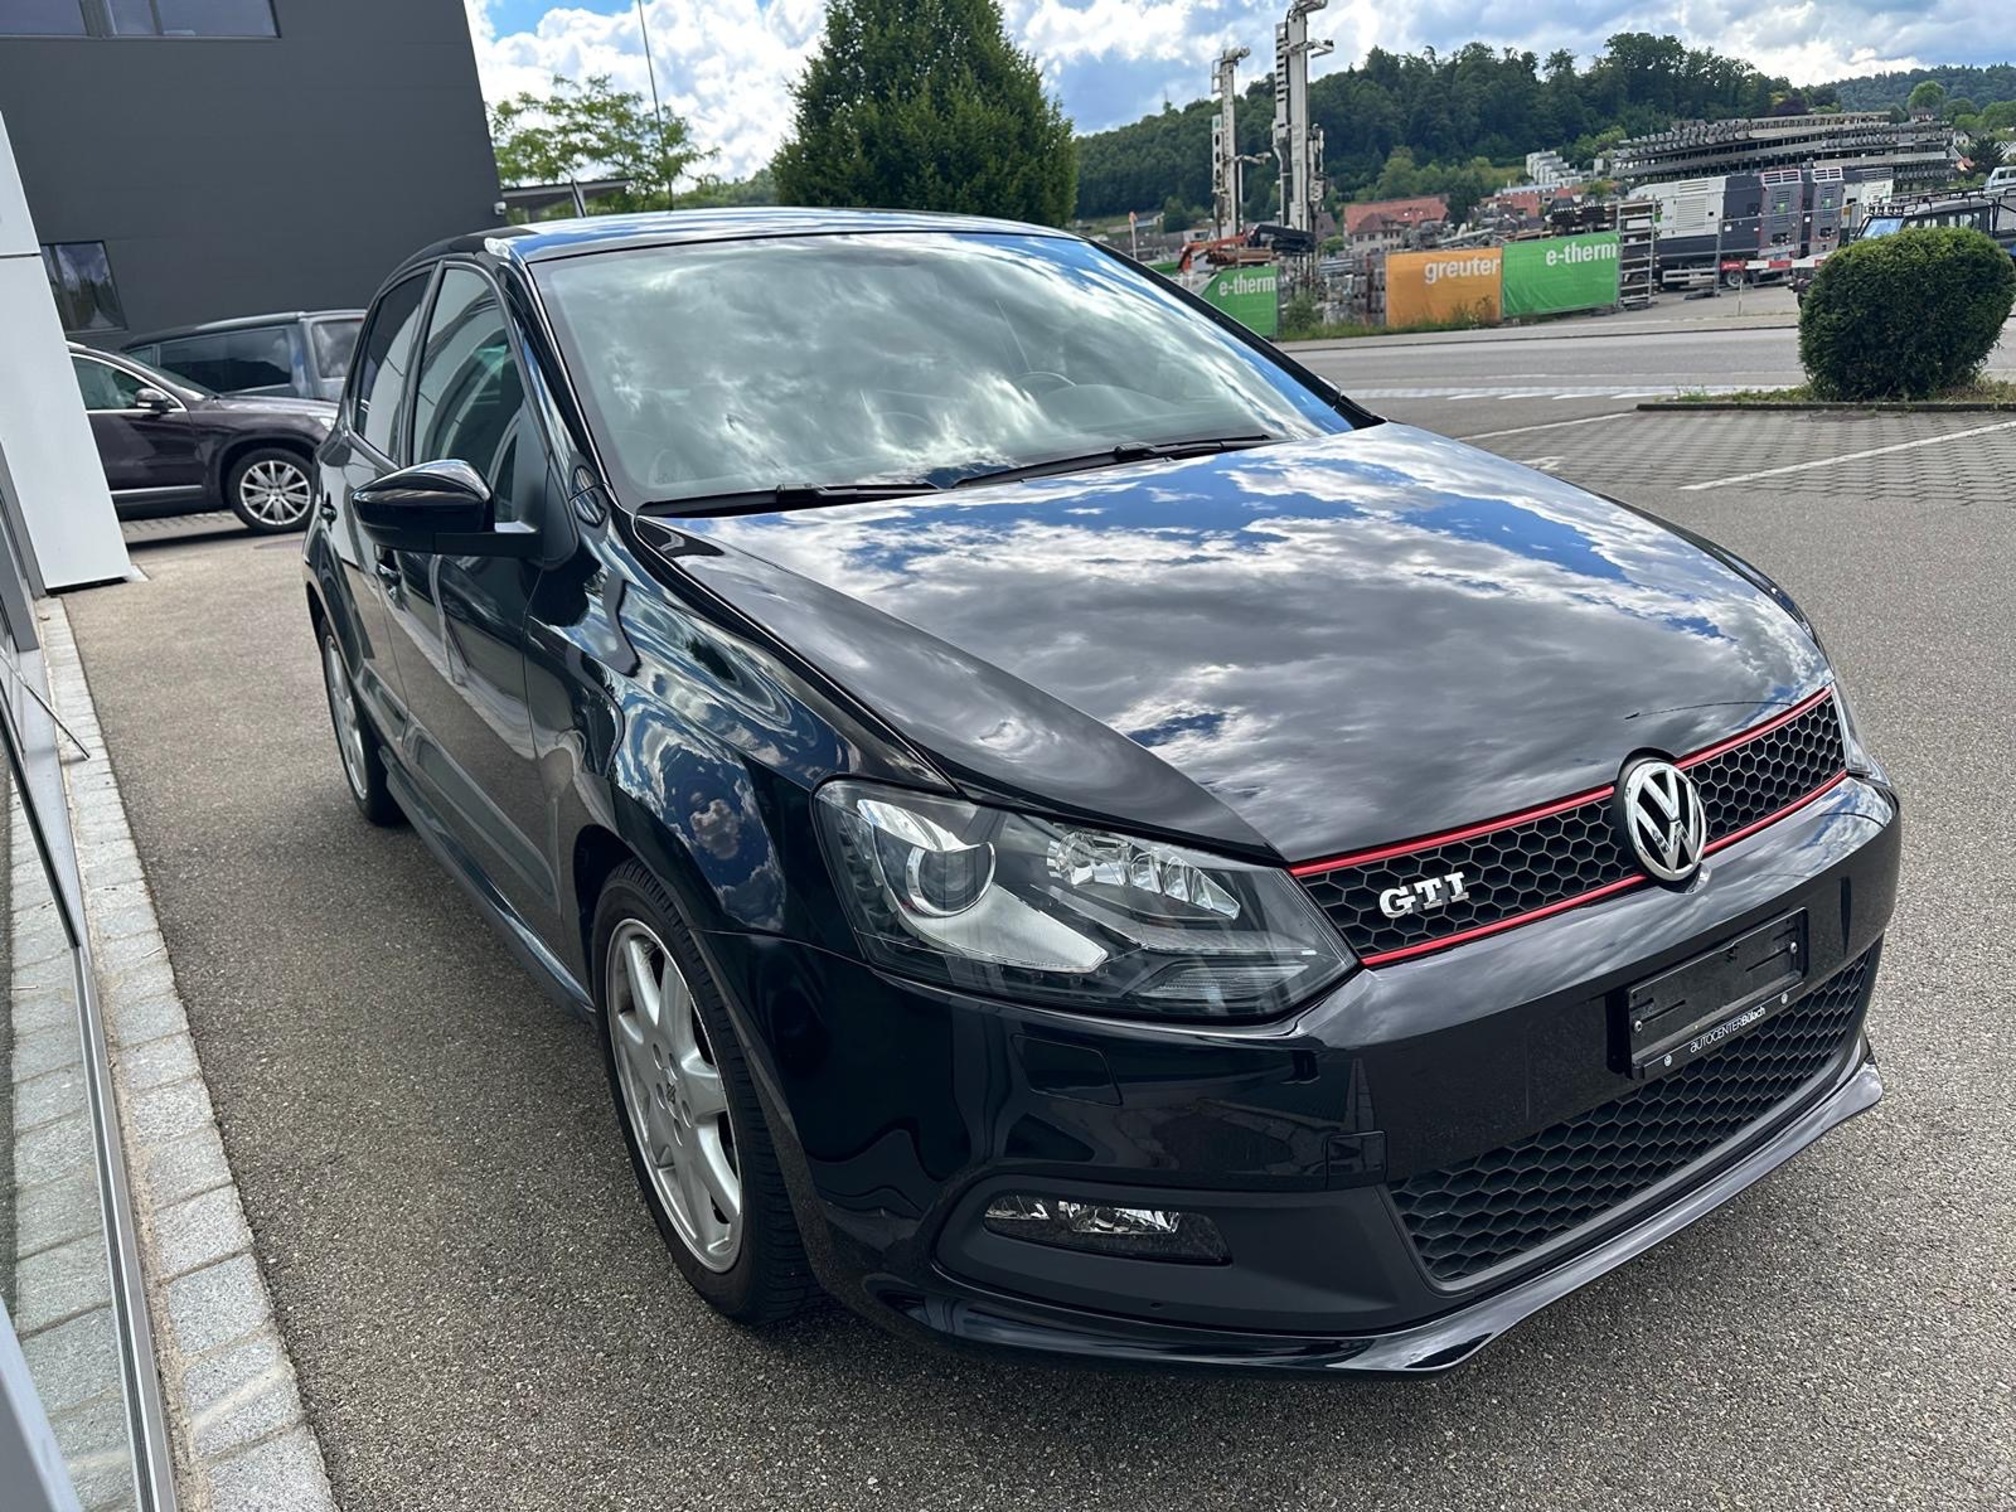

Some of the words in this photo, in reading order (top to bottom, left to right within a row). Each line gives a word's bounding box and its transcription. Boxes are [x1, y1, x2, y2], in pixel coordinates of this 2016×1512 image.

[1545, 242, 1618, 266] e-therm
[1424, 256, 1500, 284] greuter
[1219, 273, 1277, 297] e-therm
[1379, 872, 1470, 919] GTI
